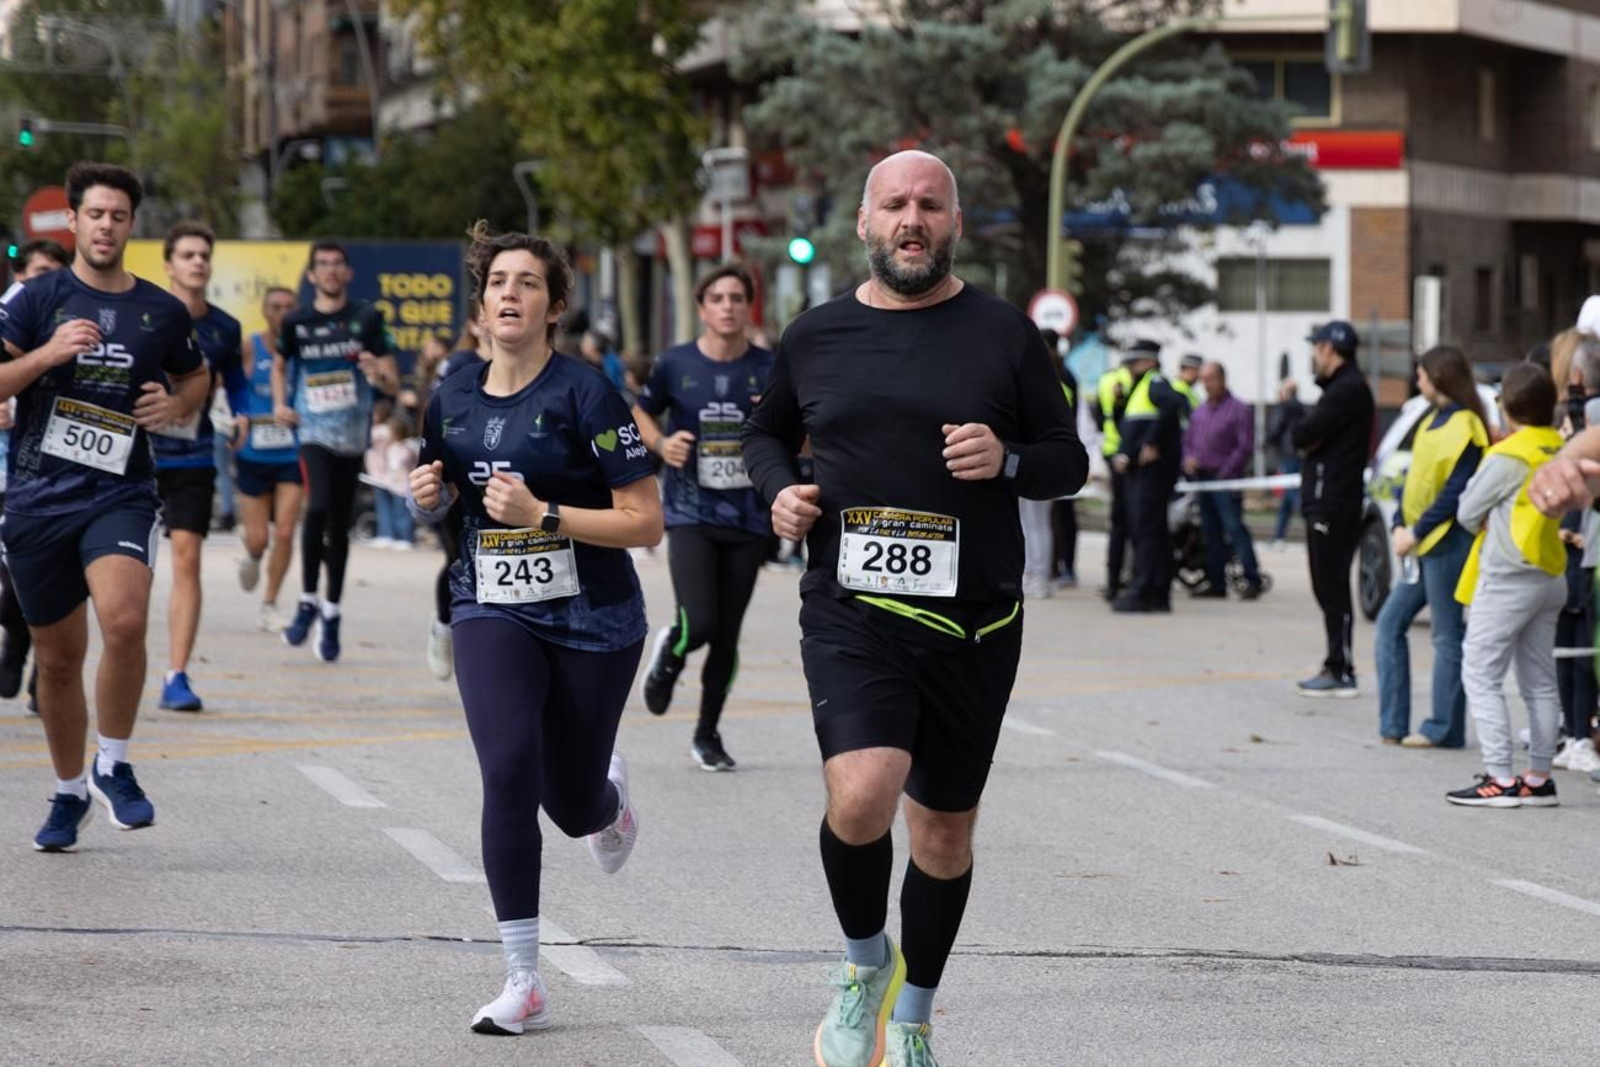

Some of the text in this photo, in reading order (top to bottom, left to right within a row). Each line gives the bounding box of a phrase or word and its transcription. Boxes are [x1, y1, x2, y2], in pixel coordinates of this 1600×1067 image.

[378, 273, 453, 297] TODO
[401, 300, 452, 324] QUE
[698, 401, 745, 422] 25
[63, 425, 113, 456] 500
[846, 511, 872, 526] XXV
[881, 518, 906, 528] gran
[909, 521, 954, 532] caminata
[481, 533, 500, 548] XXV
[861, 541, 932, 576] 288
[494, 556, 554, 586] 243
